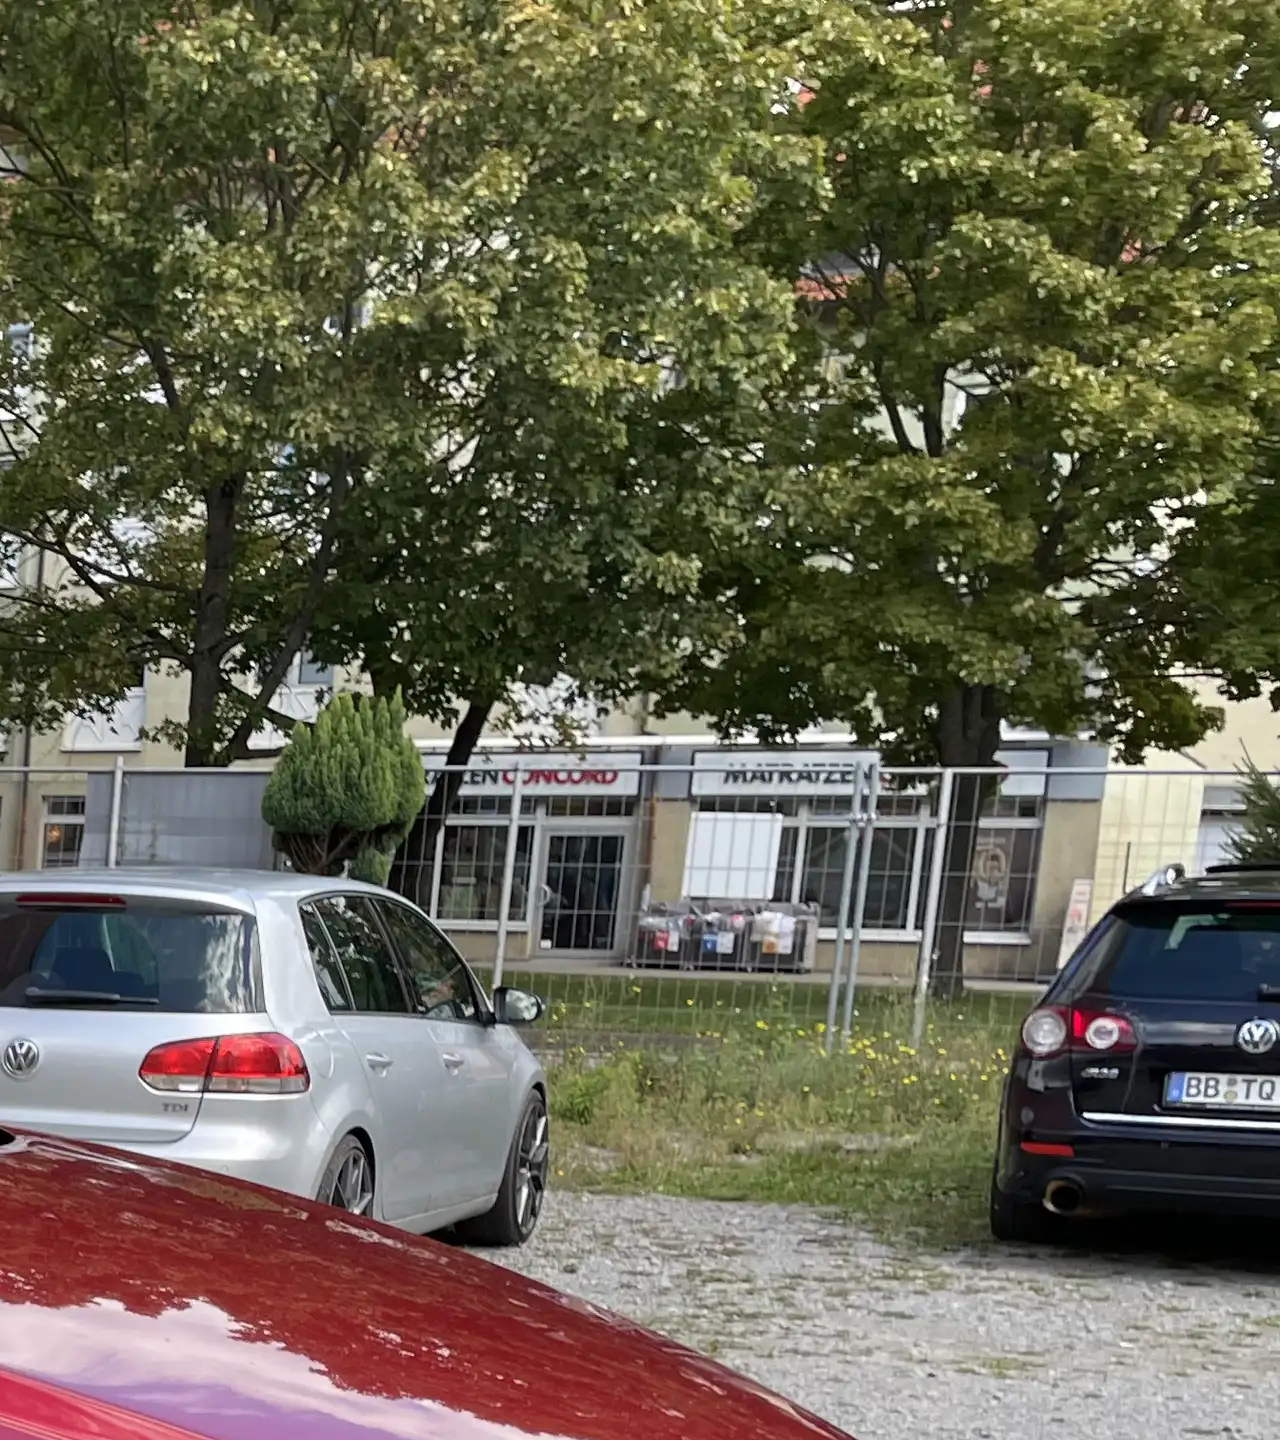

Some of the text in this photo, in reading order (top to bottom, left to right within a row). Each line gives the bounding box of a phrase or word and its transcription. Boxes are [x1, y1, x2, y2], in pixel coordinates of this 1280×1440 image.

[1185, 1077, 1276, 1101] BB TQ
[162, 1102, 189, 1113] TDI
